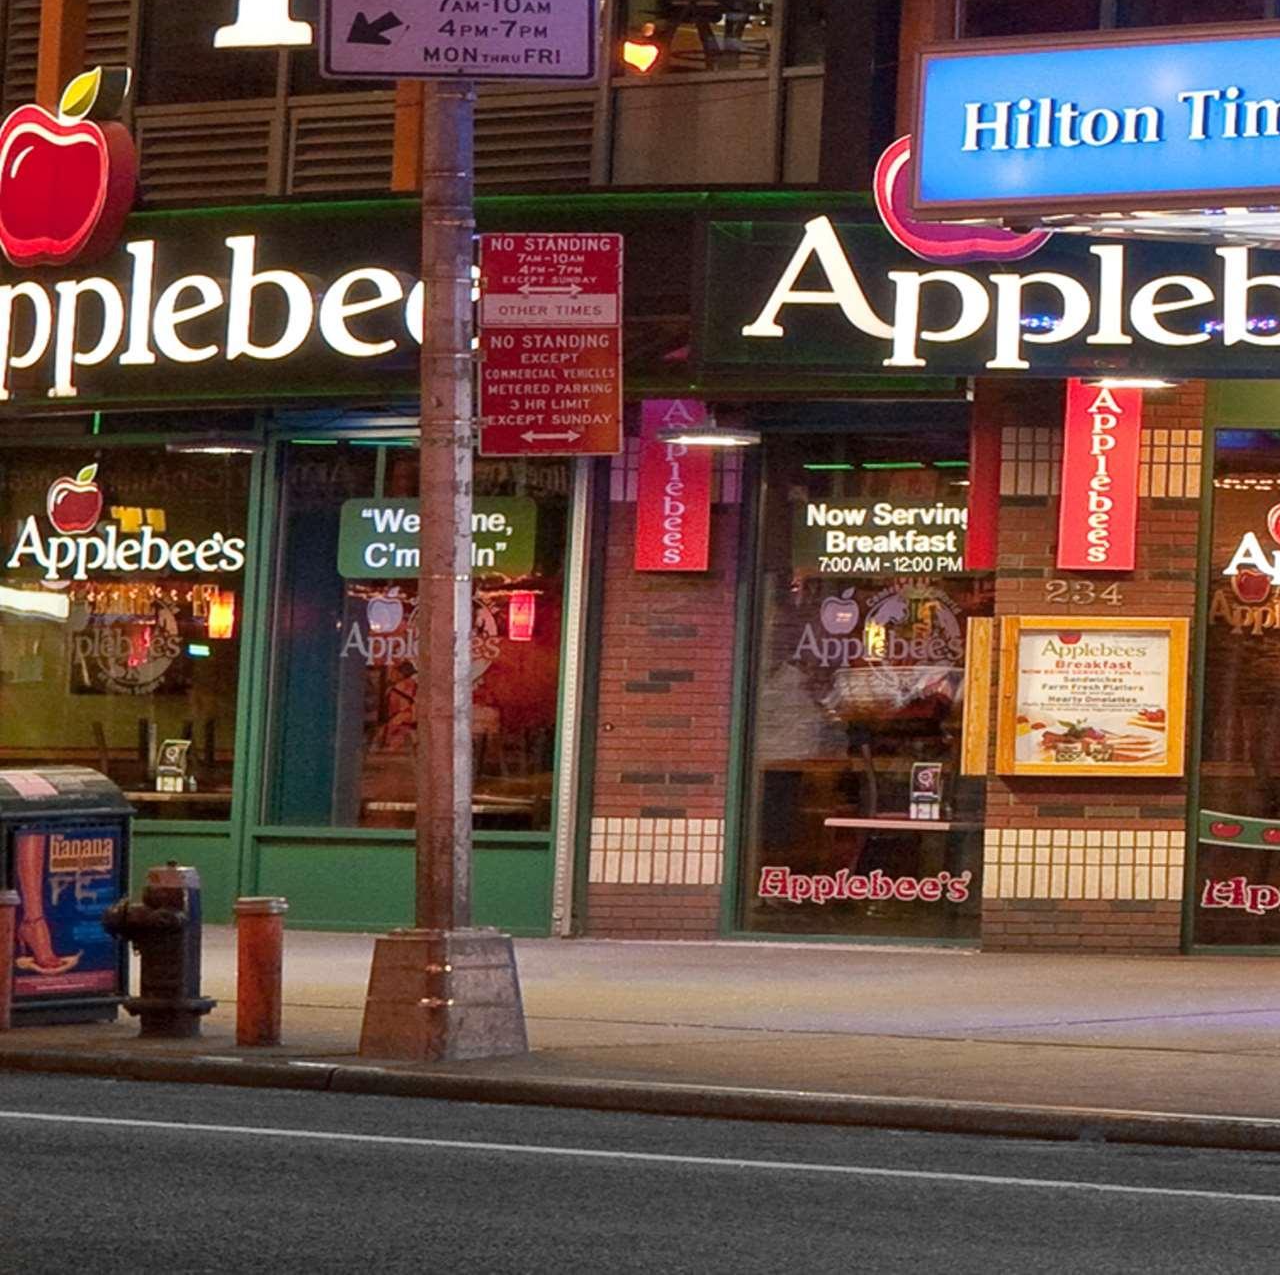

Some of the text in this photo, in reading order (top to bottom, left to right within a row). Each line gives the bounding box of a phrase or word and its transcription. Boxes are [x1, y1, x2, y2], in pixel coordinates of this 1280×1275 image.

[438, 20, 548, 39] 4PM-7PM
[423, 47, 561, 64] MON THRU FRI
[961, 96, 1160, 151] Hilton
[491, 238, 611, 252] NO STANDING
[502, 276, 598, 285] EXCEPT SUNDAY
[0, 234, 479, 400] pplebe
[499, 305, 603, 316] OTHER TIMES
[490, 335, 610, 349] NO STANDING
[520, 353, 580, 364] EXCEPT
[485, 368, 557, 380] COMMERCIAL
[488, 383, 613, 395] METERED PARKING
[509, 399, 592, 410] 3 HR LIMIT
[487, 415, 613, 426] EXCEPT SUNDAY
[661, 398, 695, 565] Aplebee's
[807, 503, 866, 526] Now
[7, 515, 245, 580] Applebee's
[826, 530, 957, 553] Breakfast
[819, 557, 851, 572] 7:00
[853, 557, 880, 572] AM
[893, 557, 933, 572] 12:00
[937, 557, 963, 572] PM
[1045, 580, 1123, 605] 234
[1055, 660, 1132, 670] Breakfast
[758, 866, 972, 904] Applebee's
